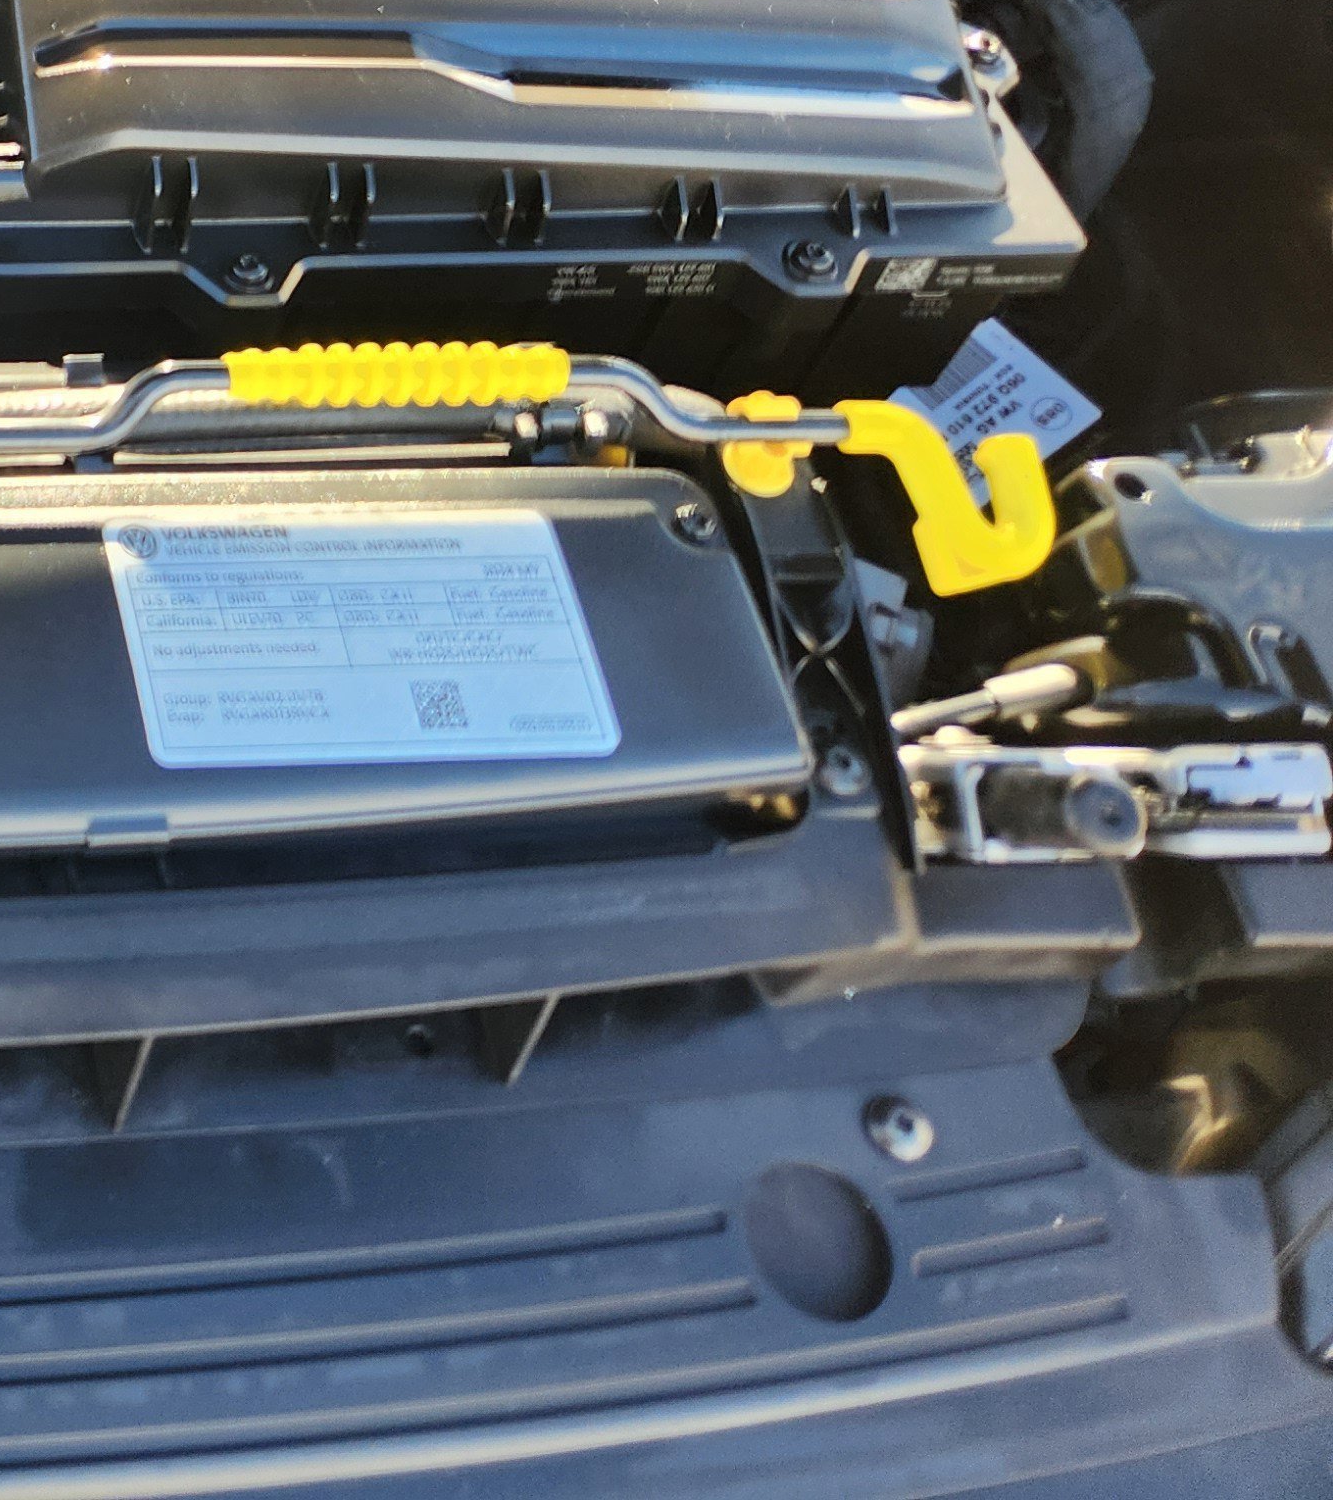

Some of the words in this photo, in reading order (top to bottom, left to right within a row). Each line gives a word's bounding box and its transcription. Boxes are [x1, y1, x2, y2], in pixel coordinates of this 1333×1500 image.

[976, 415, 996, 434] AG
[159, 524, 287, 539] VOLKSWAGEN
[165, 542, 220, 555] VEHICLE
[223, 541, 290, 554] EMISSION
[293, 539, 358, 552] CONTROL
[361, 537, 462, 551] INFORMATION
[135, 571, 201, 584] Conforms
[204, 571, 219, 582] to
[140, 593, 165, 605] U.S.
[169, 593, 200, 604] EPA:
[145, 613, 217, 626] California:
[152, 645, 172, 656] No
[175, 642, 263, 657] adjustments
[162, 692, 211, 707] Group:
[166, 711, 205, 723] Evap:
